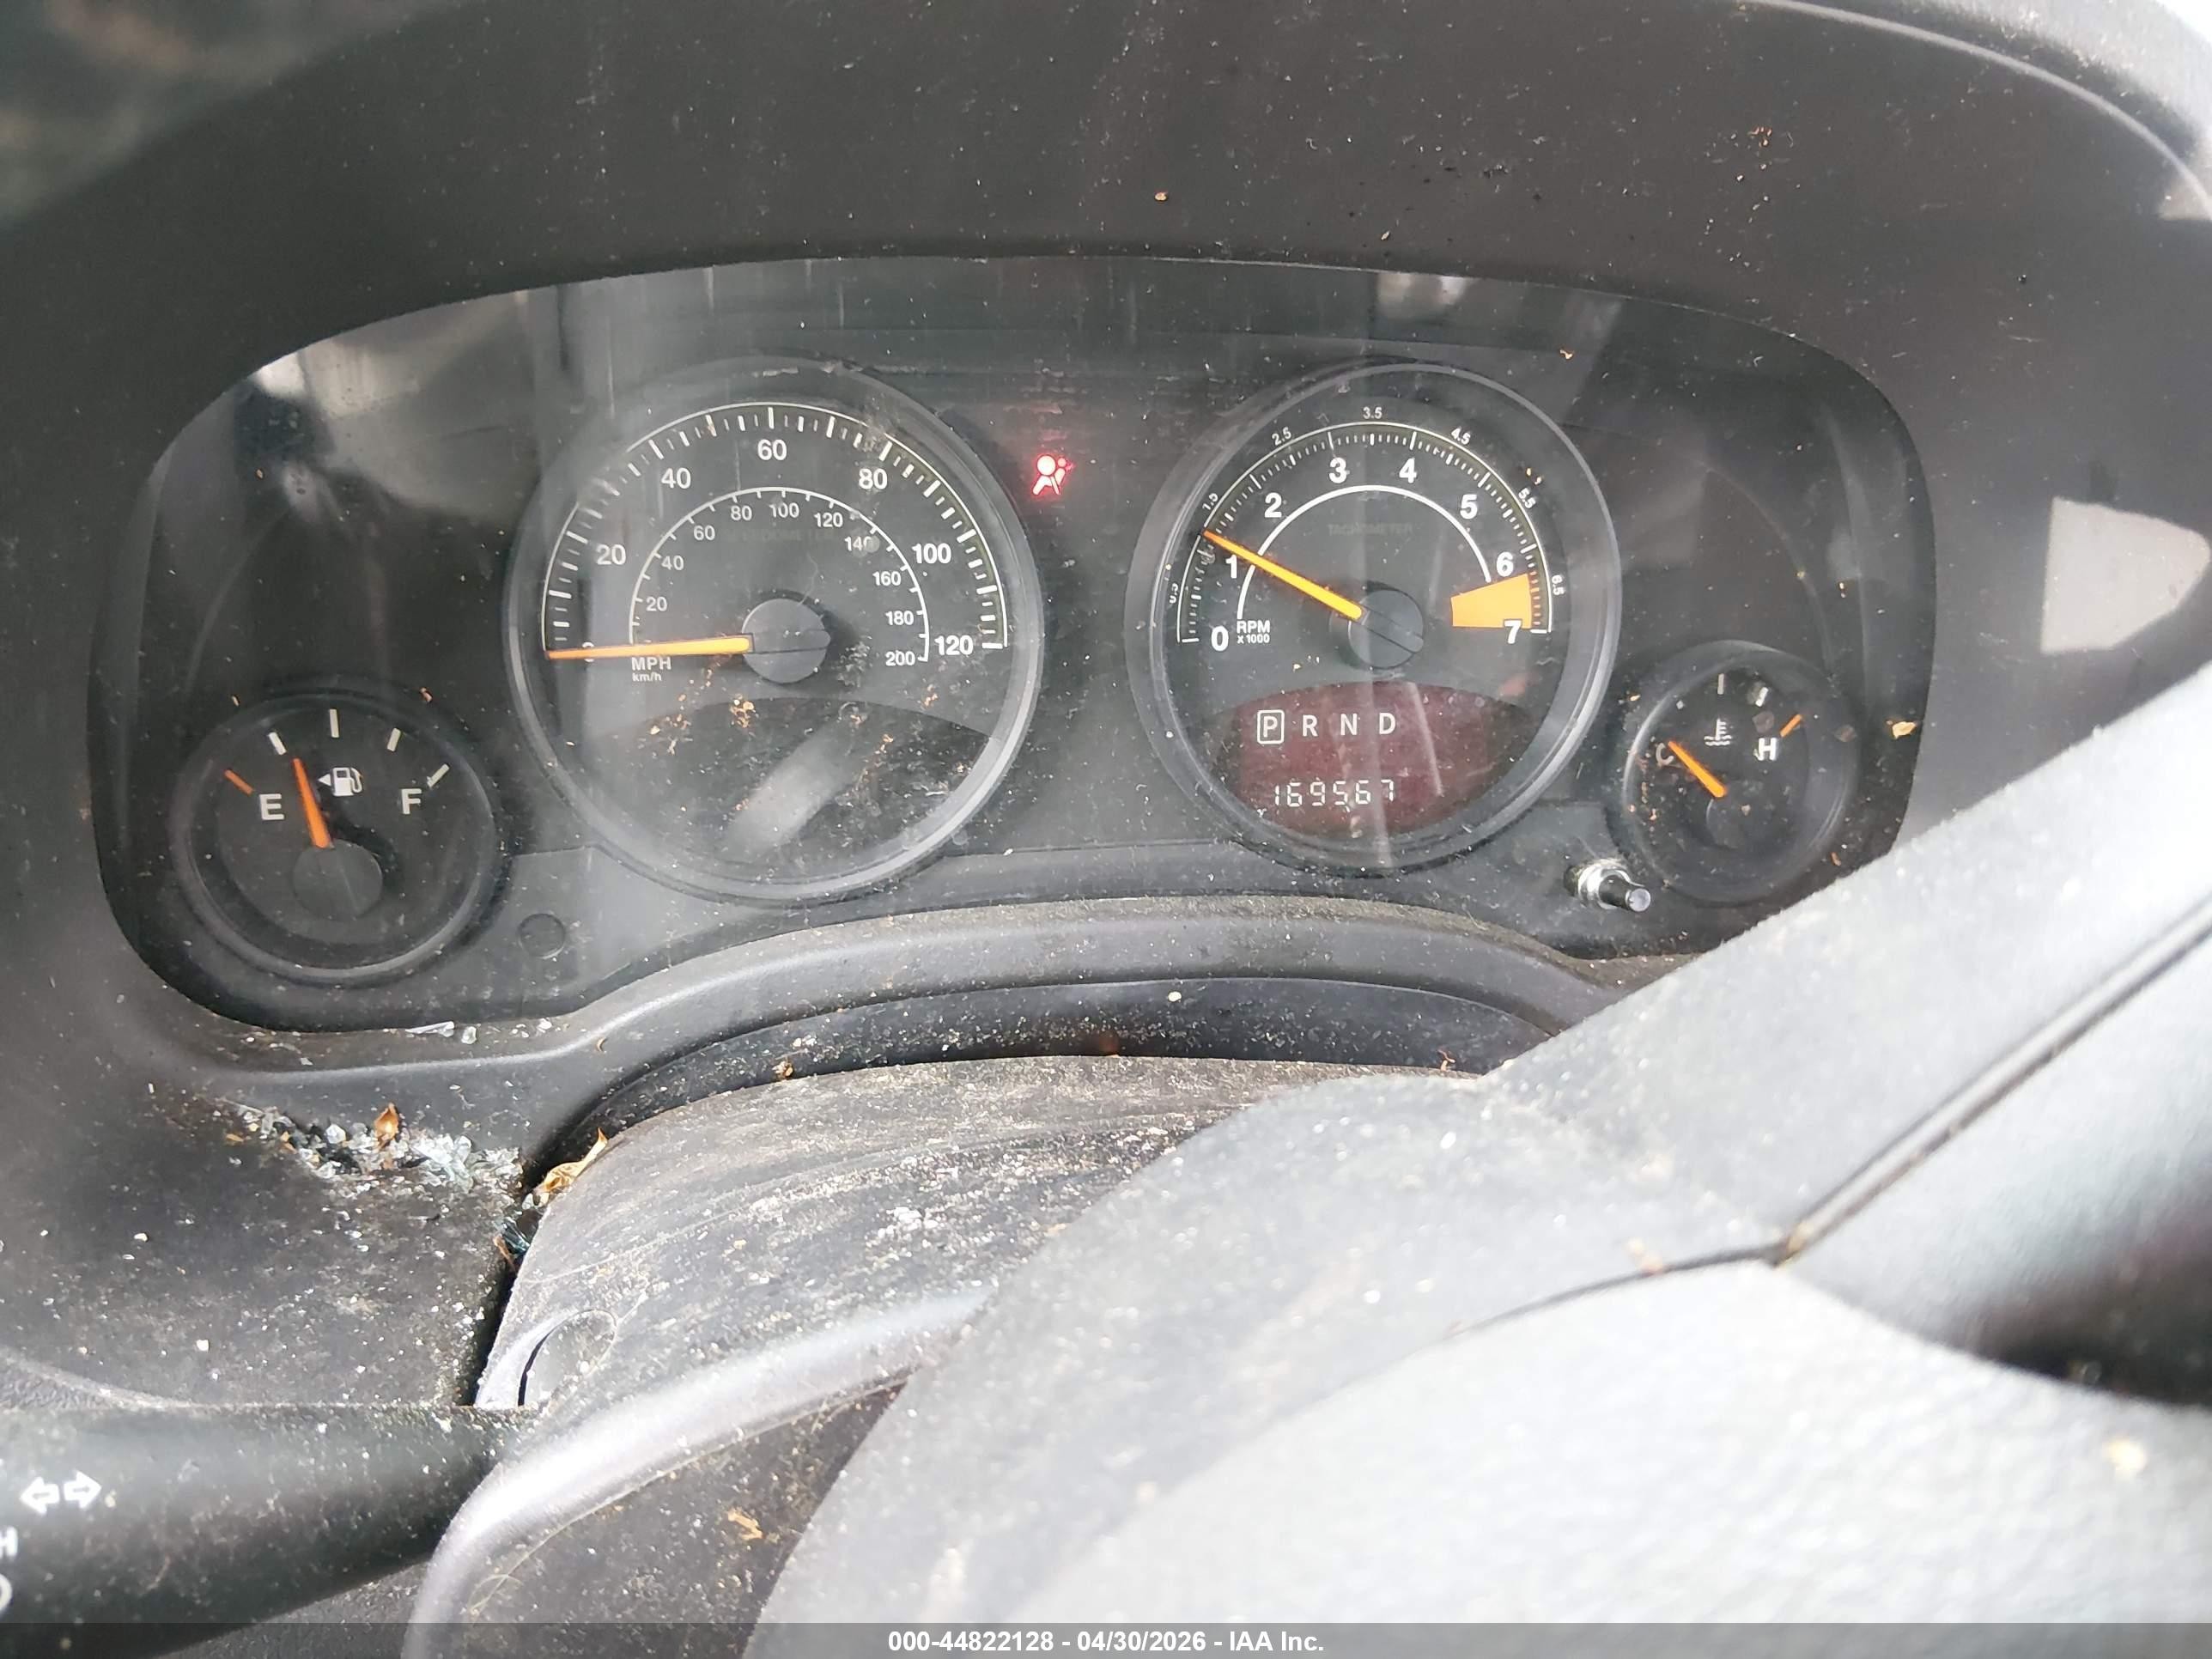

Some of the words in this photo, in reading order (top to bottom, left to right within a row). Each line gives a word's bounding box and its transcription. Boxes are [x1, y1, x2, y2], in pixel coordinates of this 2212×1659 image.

[1362, 406, 1382, 419] 3.5
[1272, 427, 1292, 446] 2.5
[1450, 428, 1471, 446] 4.5
[757, 439, 787, 460] 60
[660, 468, 691, 489] 40
[859, 468, 888, 489] 80
[1328, 457, 1347, 483] 3
[1399, 458, 1417, 483] 4
[1264, 492, 1283, 518] 2
[1460, 494, 1478, 520] 5
[1518, 487, 1536, 508] 5.5
[730, 505, 752, 520] 80
[769, 502, 799, 518] 100
[814, 513, 843, 527] 120
[693, 525, 715, 540] 60
[597, 544, 626, 565] 20
[661, 556, 684, 570] 40
[912, 543, 951, 563] 100
[1225, 554, 1237, 579] 1
[1496, 551, 1514, 577] 6
[872, 571, 901, 586] 160
[1551, 574, 1565, 596] 6.5
[647, 597, 667, 611] 20
[885, 611, 914, 625] 180
[1237, 620, 1271, 634] RPM
[1211, 625, 1229, 652] 0
[1504, 621, 1522, 644] 7
[934, 635, 974, 655] 120
[631, 656, 672, 671] MPH
[885, 651, 915, 666] 200
[631, 672, 662, 682] km/h
[1263, 716, 1278, 738] P
[1303, 714, 1318, 736] R
[1340, 714, 1358, 736] N
[1379, 713, 1396, 735] D
[1759, 738, 1778, 761] H
[401, 788, 422, 815] F
[1274, 779, 1394, 807] 169567
[259, 793, 284, 821] E
